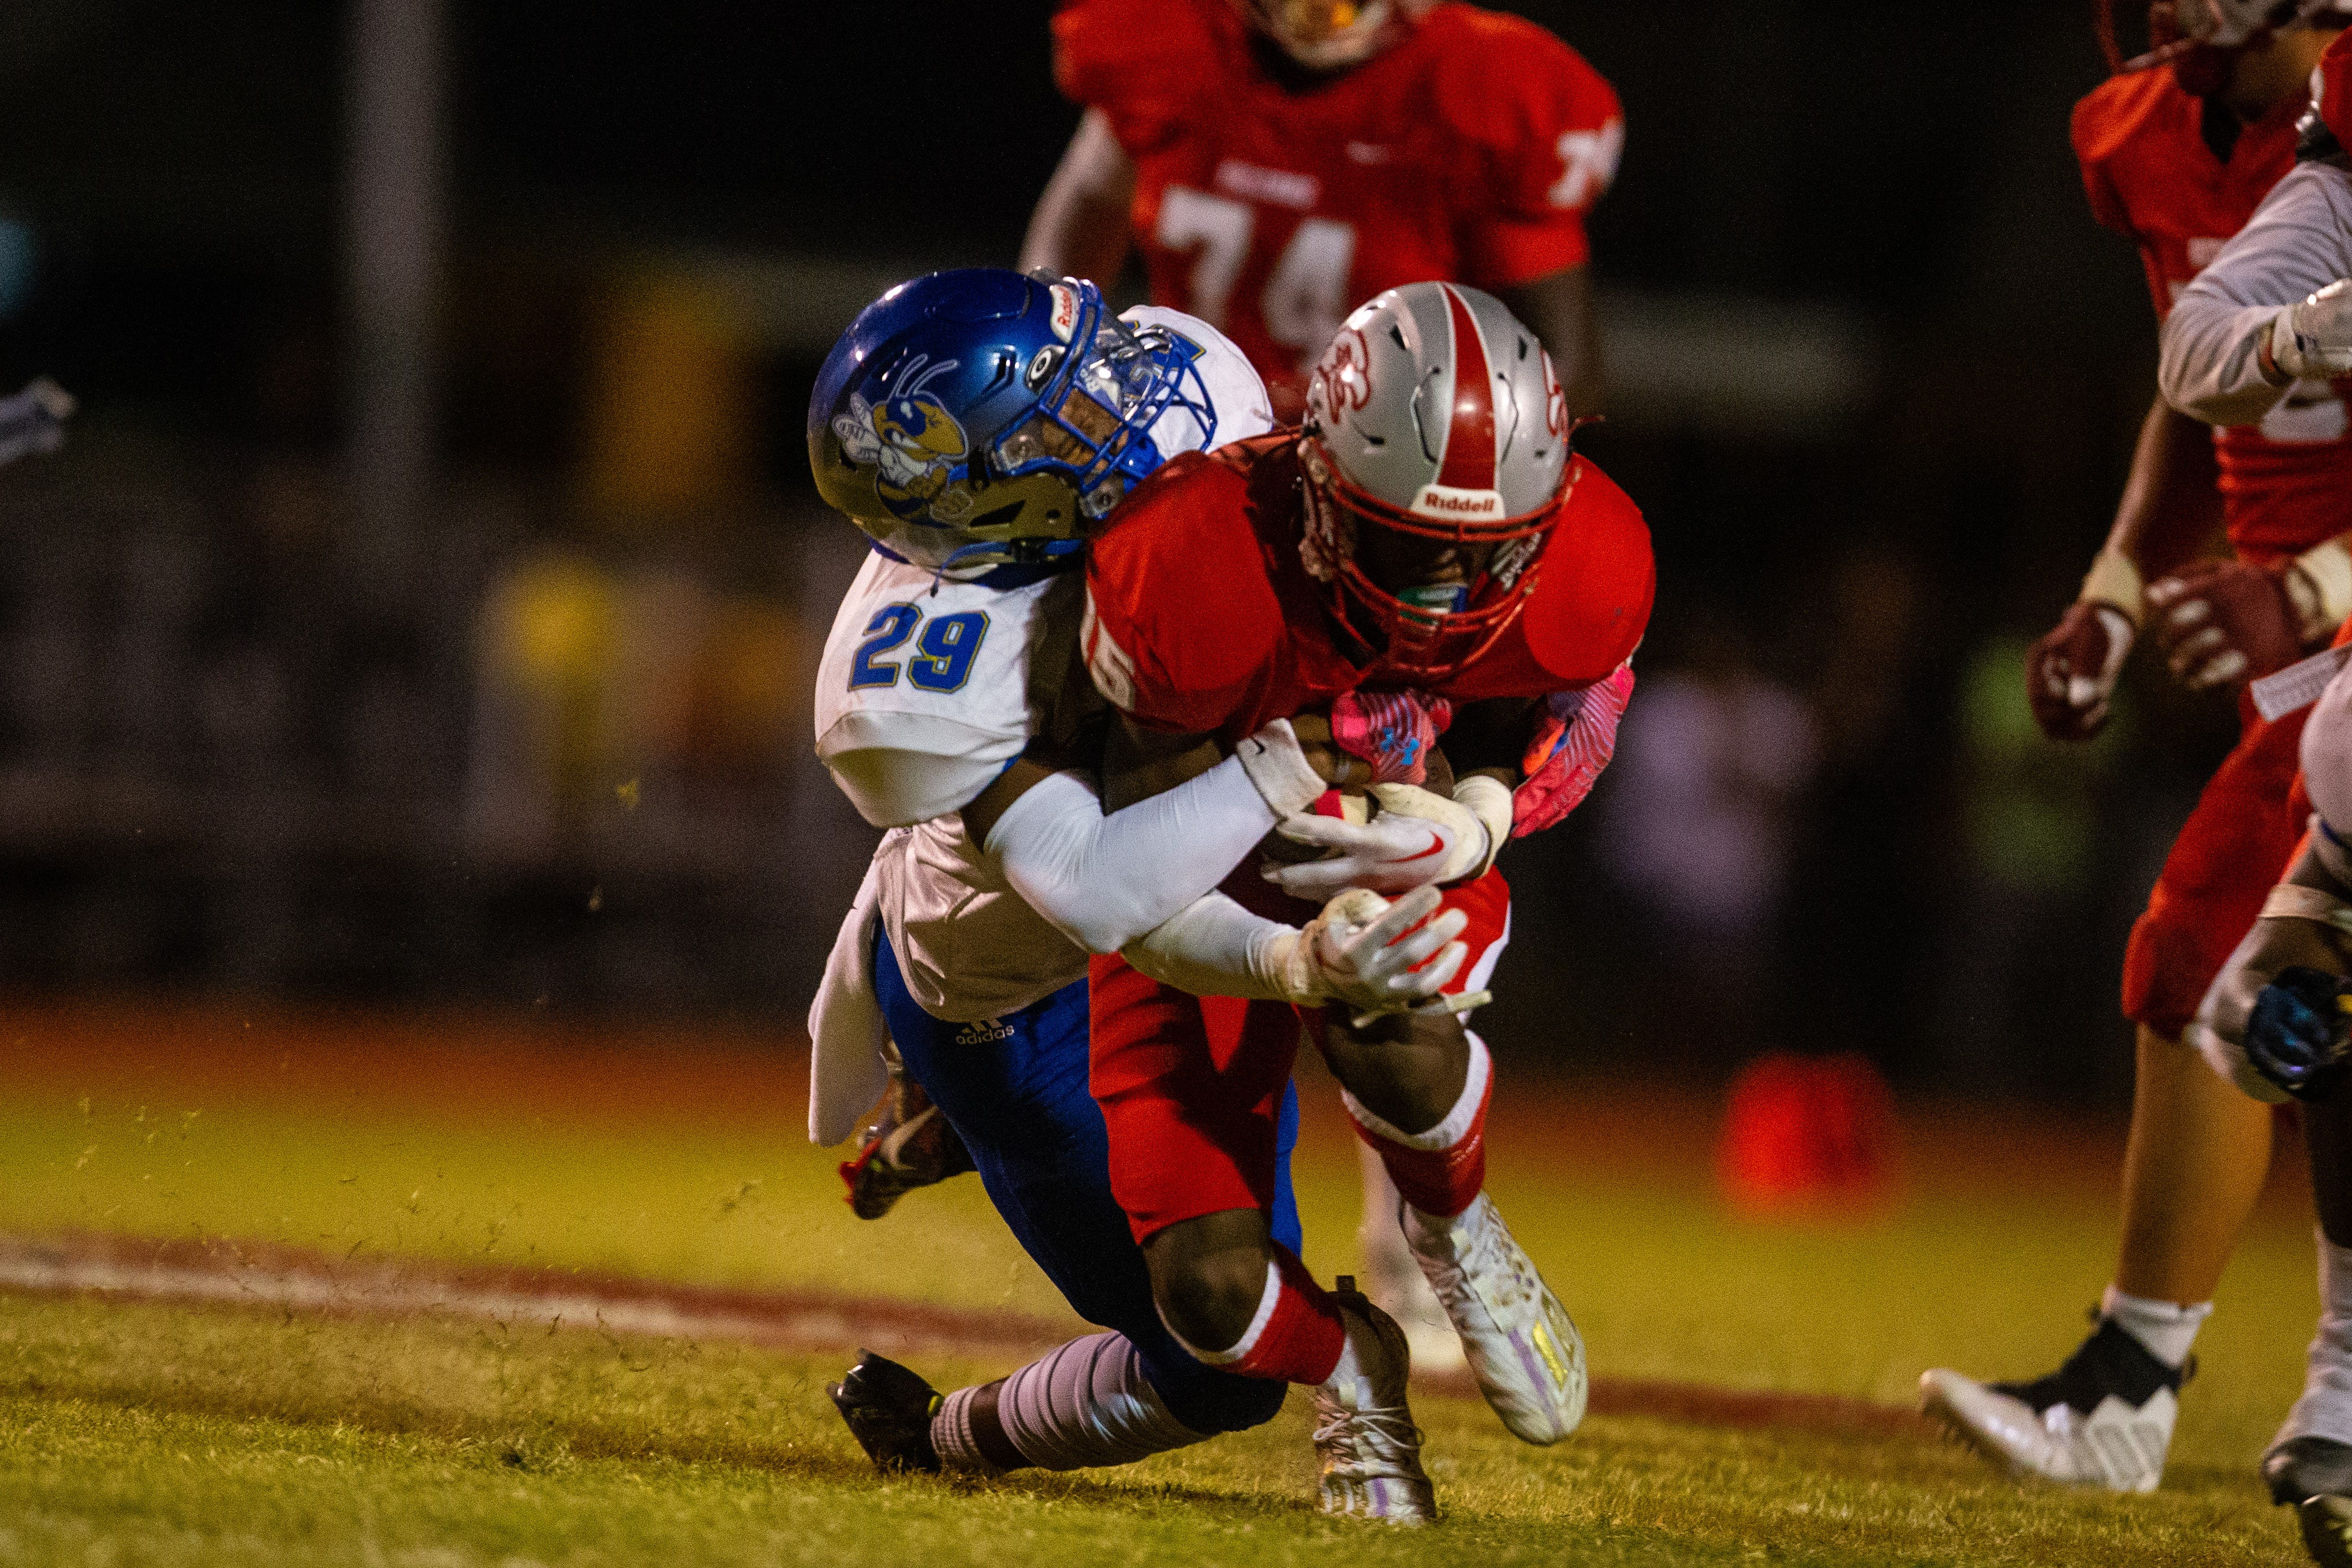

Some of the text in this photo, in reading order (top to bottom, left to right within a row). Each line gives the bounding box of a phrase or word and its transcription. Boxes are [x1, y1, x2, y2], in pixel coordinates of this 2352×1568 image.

[1158, 186, 1354, 372] 74
[1425, 492, 1494, 513] Riddell
[848, 602, 991, 694] 29
[955, 1025, 1015, 1044] adidas
